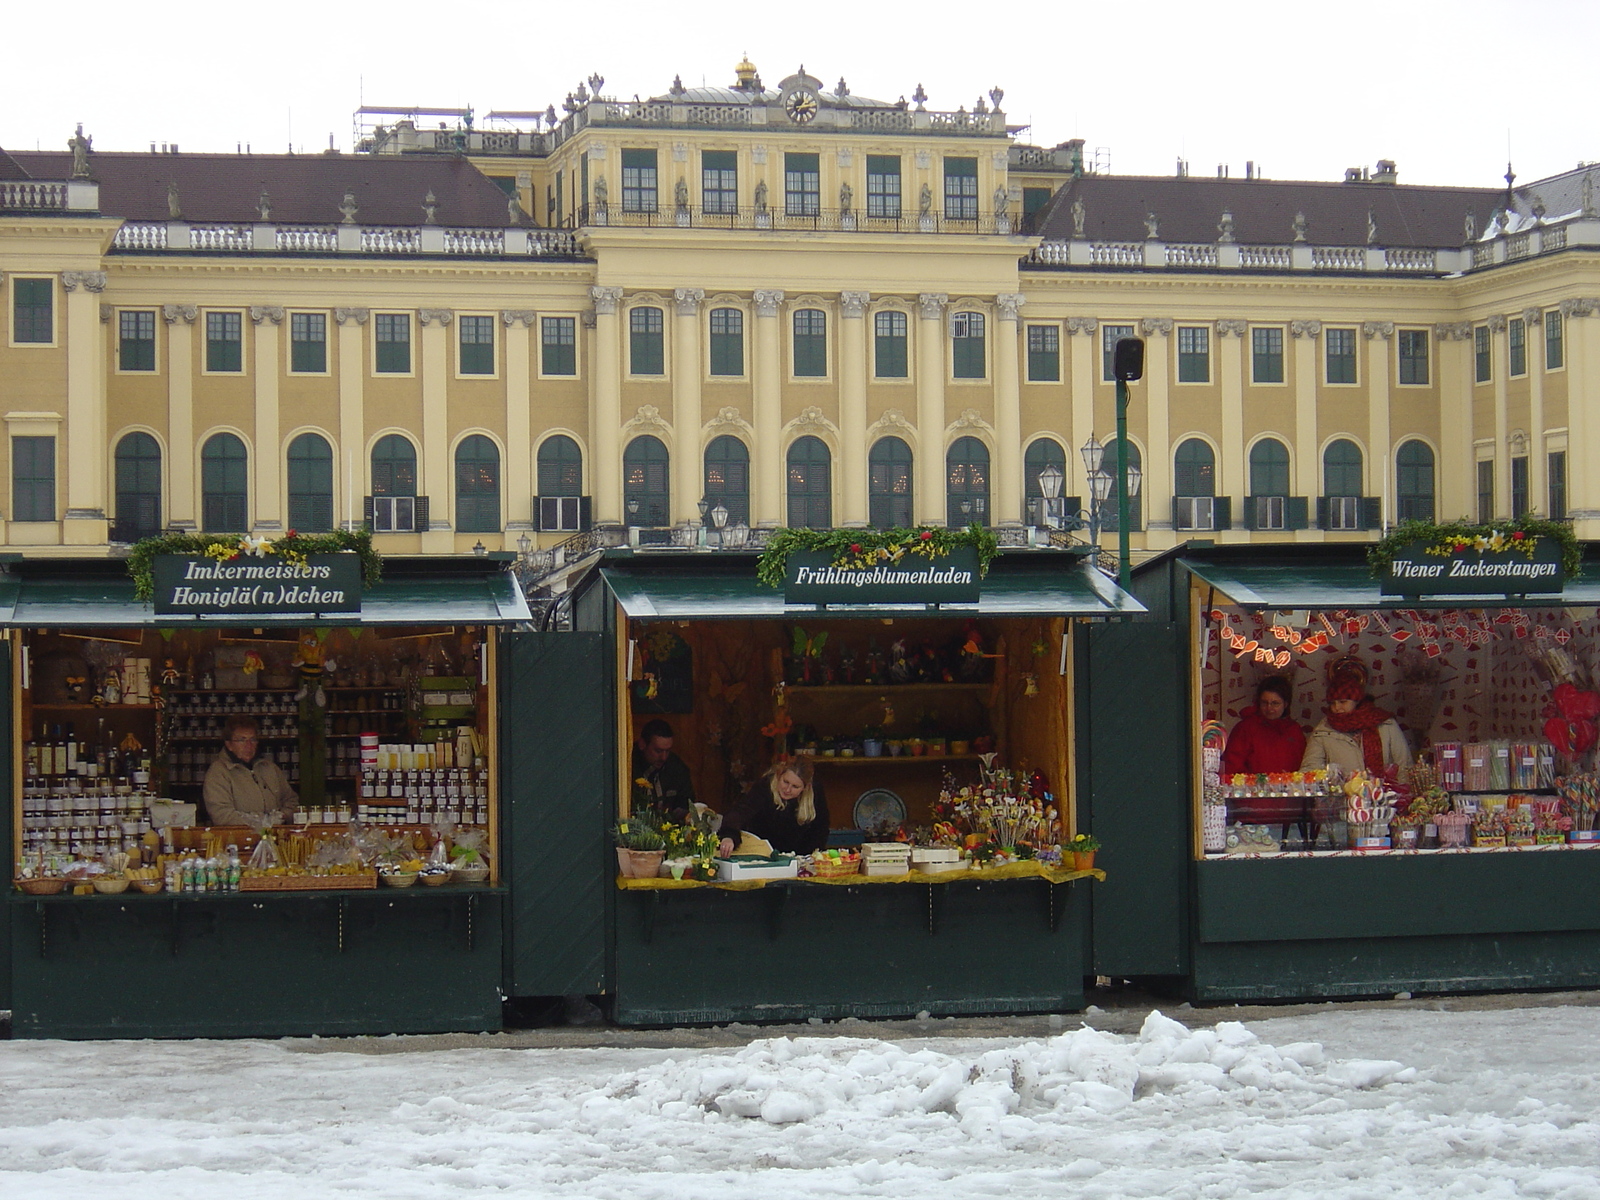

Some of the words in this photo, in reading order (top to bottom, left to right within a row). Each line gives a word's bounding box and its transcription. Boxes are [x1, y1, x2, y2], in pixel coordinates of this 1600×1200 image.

[184, 561, 331, 580] Imkermeisters
[795, 566, 972, 588] Frühlingsblumenladen
[1392, 560, 1444, 578] Wiener
[1449, 559, 1557, 579] Zuckerstangen
